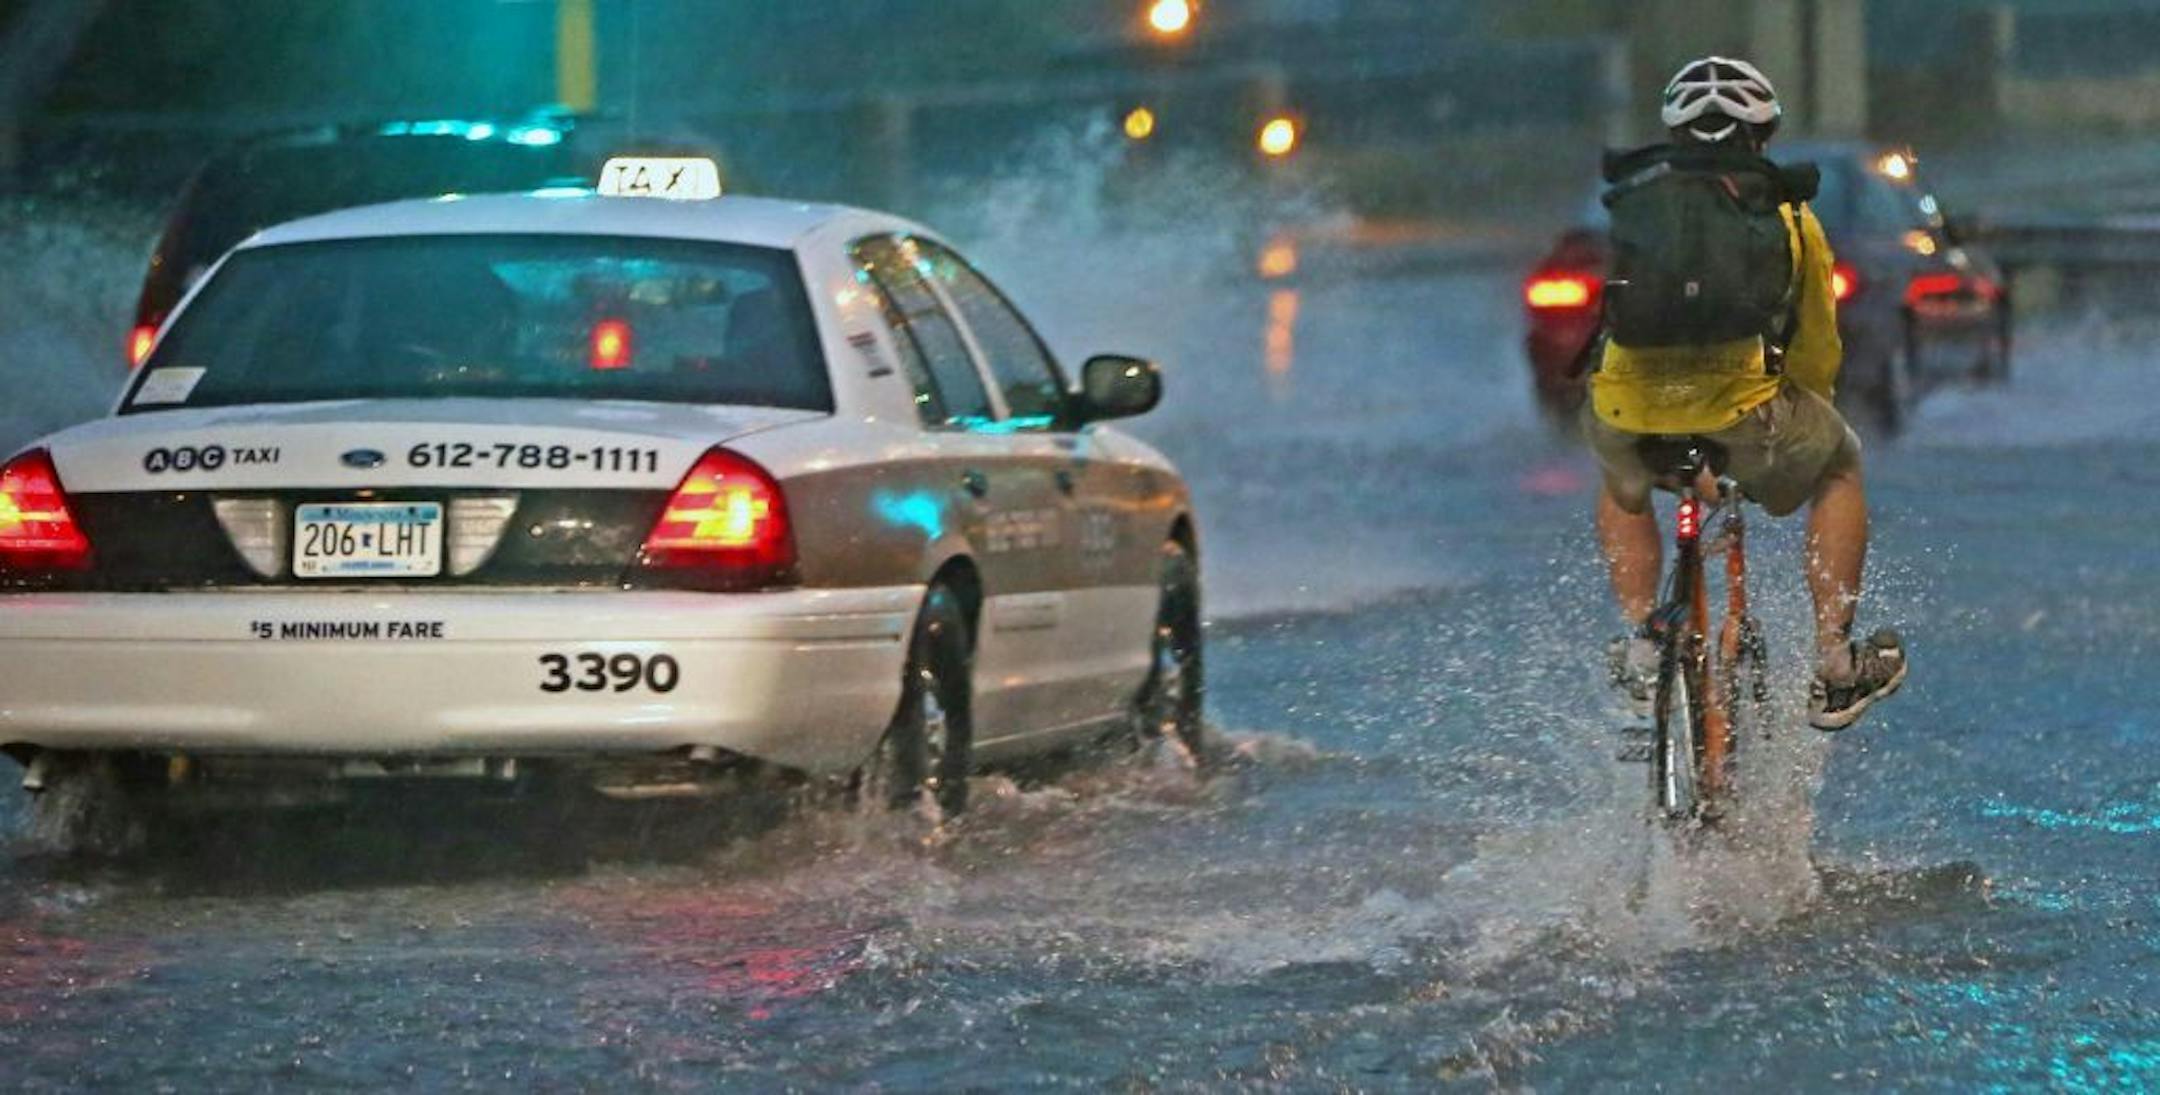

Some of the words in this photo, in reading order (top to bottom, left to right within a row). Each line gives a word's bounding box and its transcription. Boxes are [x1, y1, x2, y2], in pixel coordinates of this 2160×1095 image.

[616, 166, 702, 194] TAX
[144, 445, 225, 473] ABC
[232, 447, 280, 464] TAXI
[407, 443, 658, 473] 612-788-1111
[303, 523, 356, 557] 206
[378, 522, 431, 556] LHT
[251, 620, 273, 639] $5
[281, 621, 380, 639] MINIMUM
[387, 621, 445, 639] FARE
[538, 652, 680, 693] 3390
